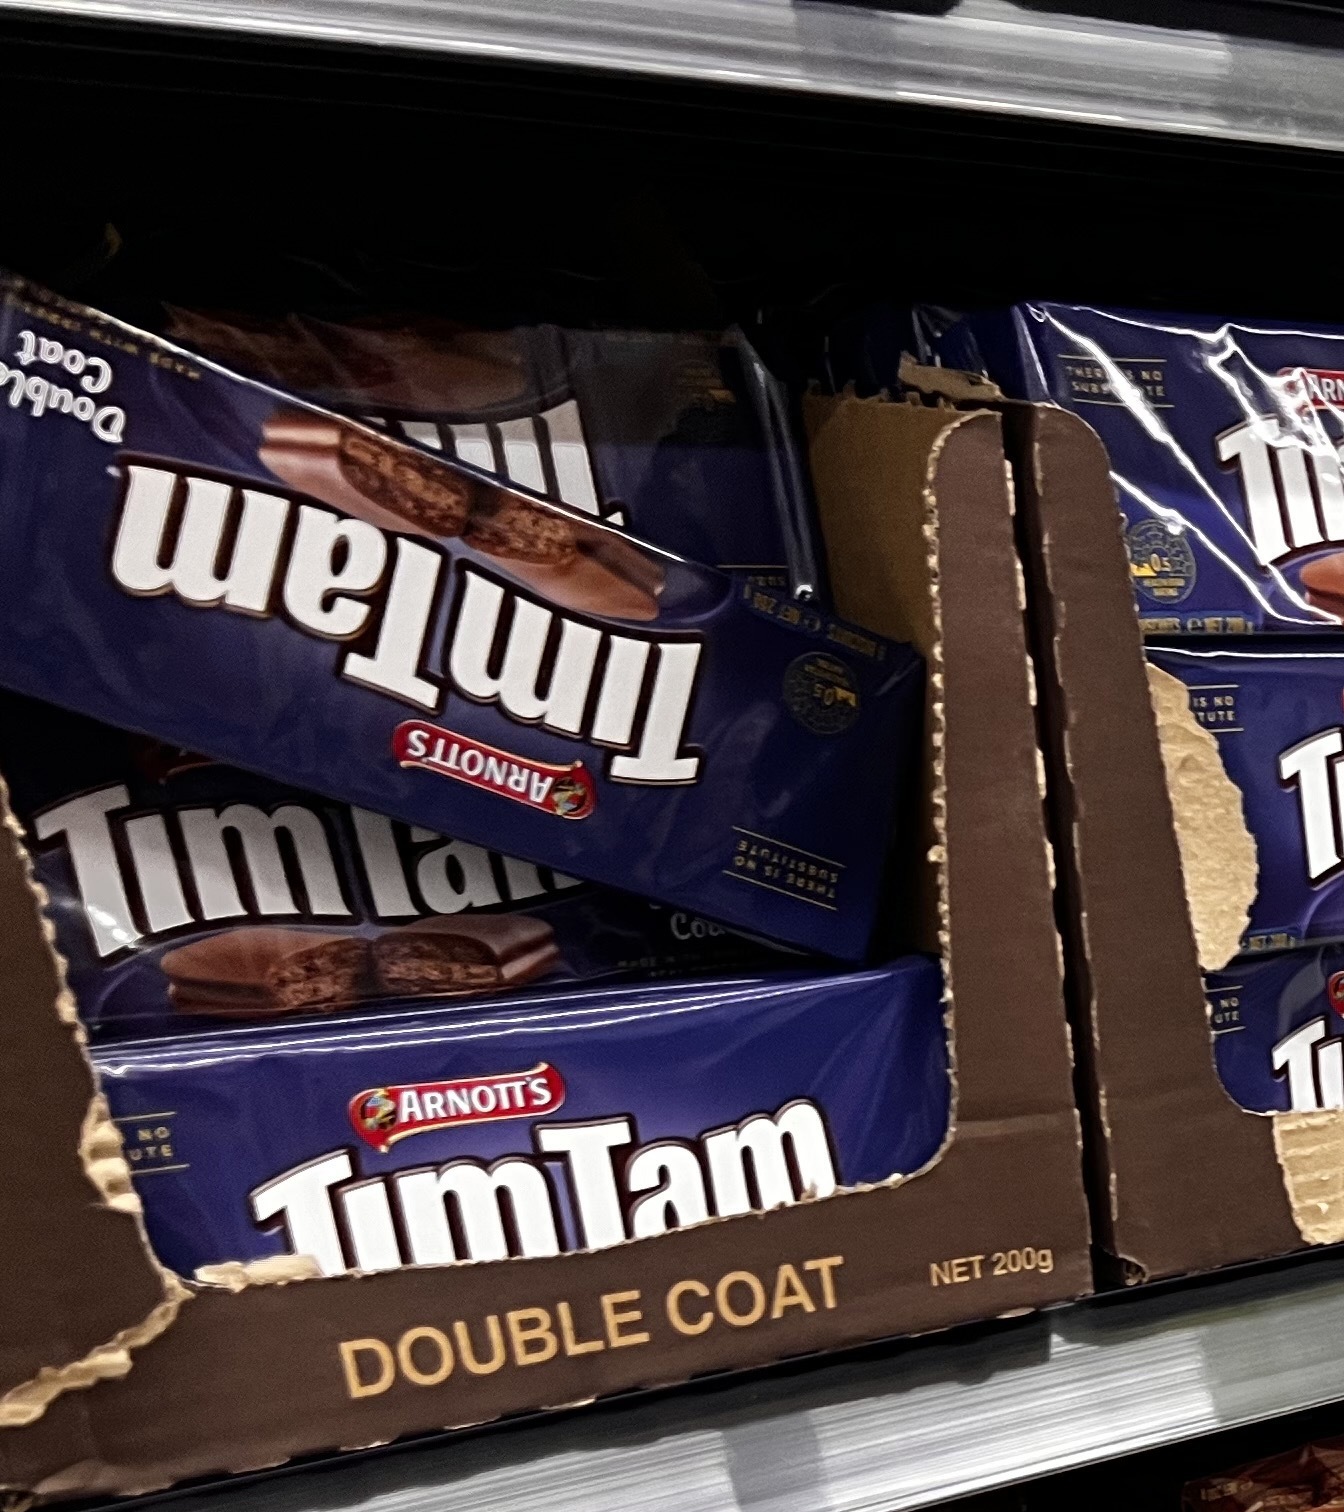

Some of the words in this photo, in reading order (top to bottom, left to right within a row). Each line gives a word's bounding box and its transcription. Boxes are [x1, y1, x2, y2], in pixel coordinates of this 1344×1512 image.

[16, 329, 114, 394] Coat
[109, 460, 704, 787] TimTam
[734, 854, 758, 872] NO
[786, 869, 838, 900] THERE
[400, 1073, 553, 1125] ARNOTT'S
[250, 1097, 838, 1277] TimTam
[929, 1255, 984, 1288] NET
[991, 1247, 1056, 1279] 200g
[338, 1289, 651, 1399] DOUBLE
[665, 1256, 845, 1337] COAT
